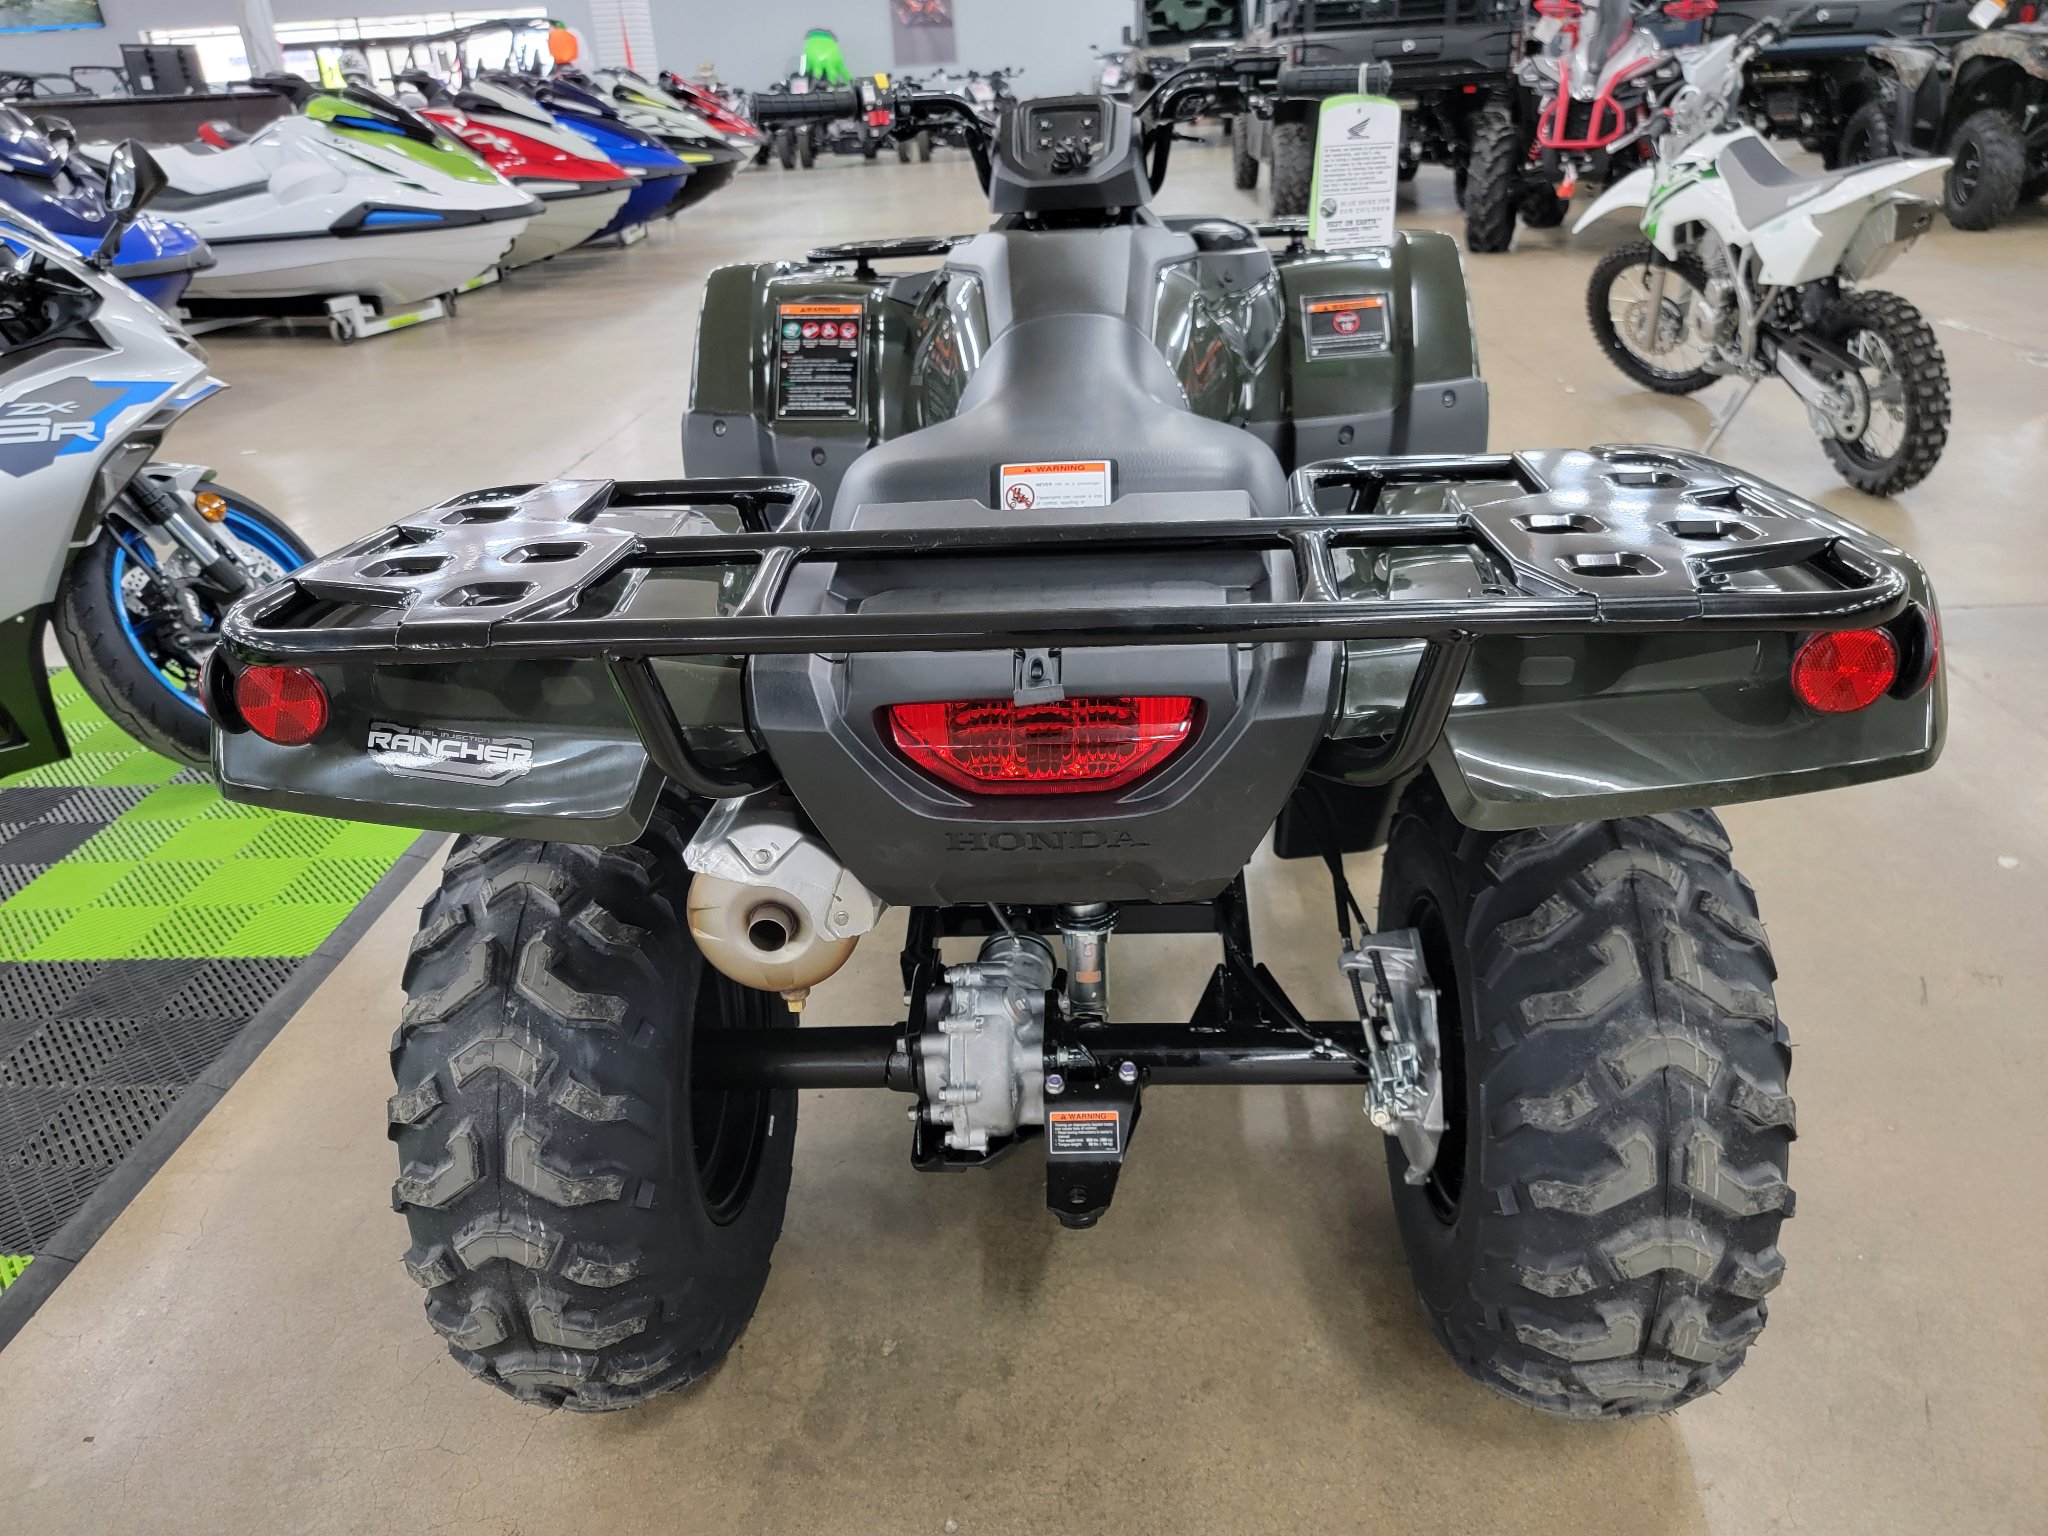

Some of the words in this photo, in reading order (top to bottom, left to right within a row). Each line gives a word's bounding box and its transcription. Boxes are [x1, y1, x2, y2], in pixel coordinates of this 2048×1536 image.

[1036, 464, 1086, 473] WARNING
[411, 728, 437, 738] FUEL
[440, 730, 490, 744] INJECTION
[367, 731, 533, 766] RANCHER
[944, 830, 1151, 851] HONDA
[1069, 1112, 1107, 1120] WARNING
